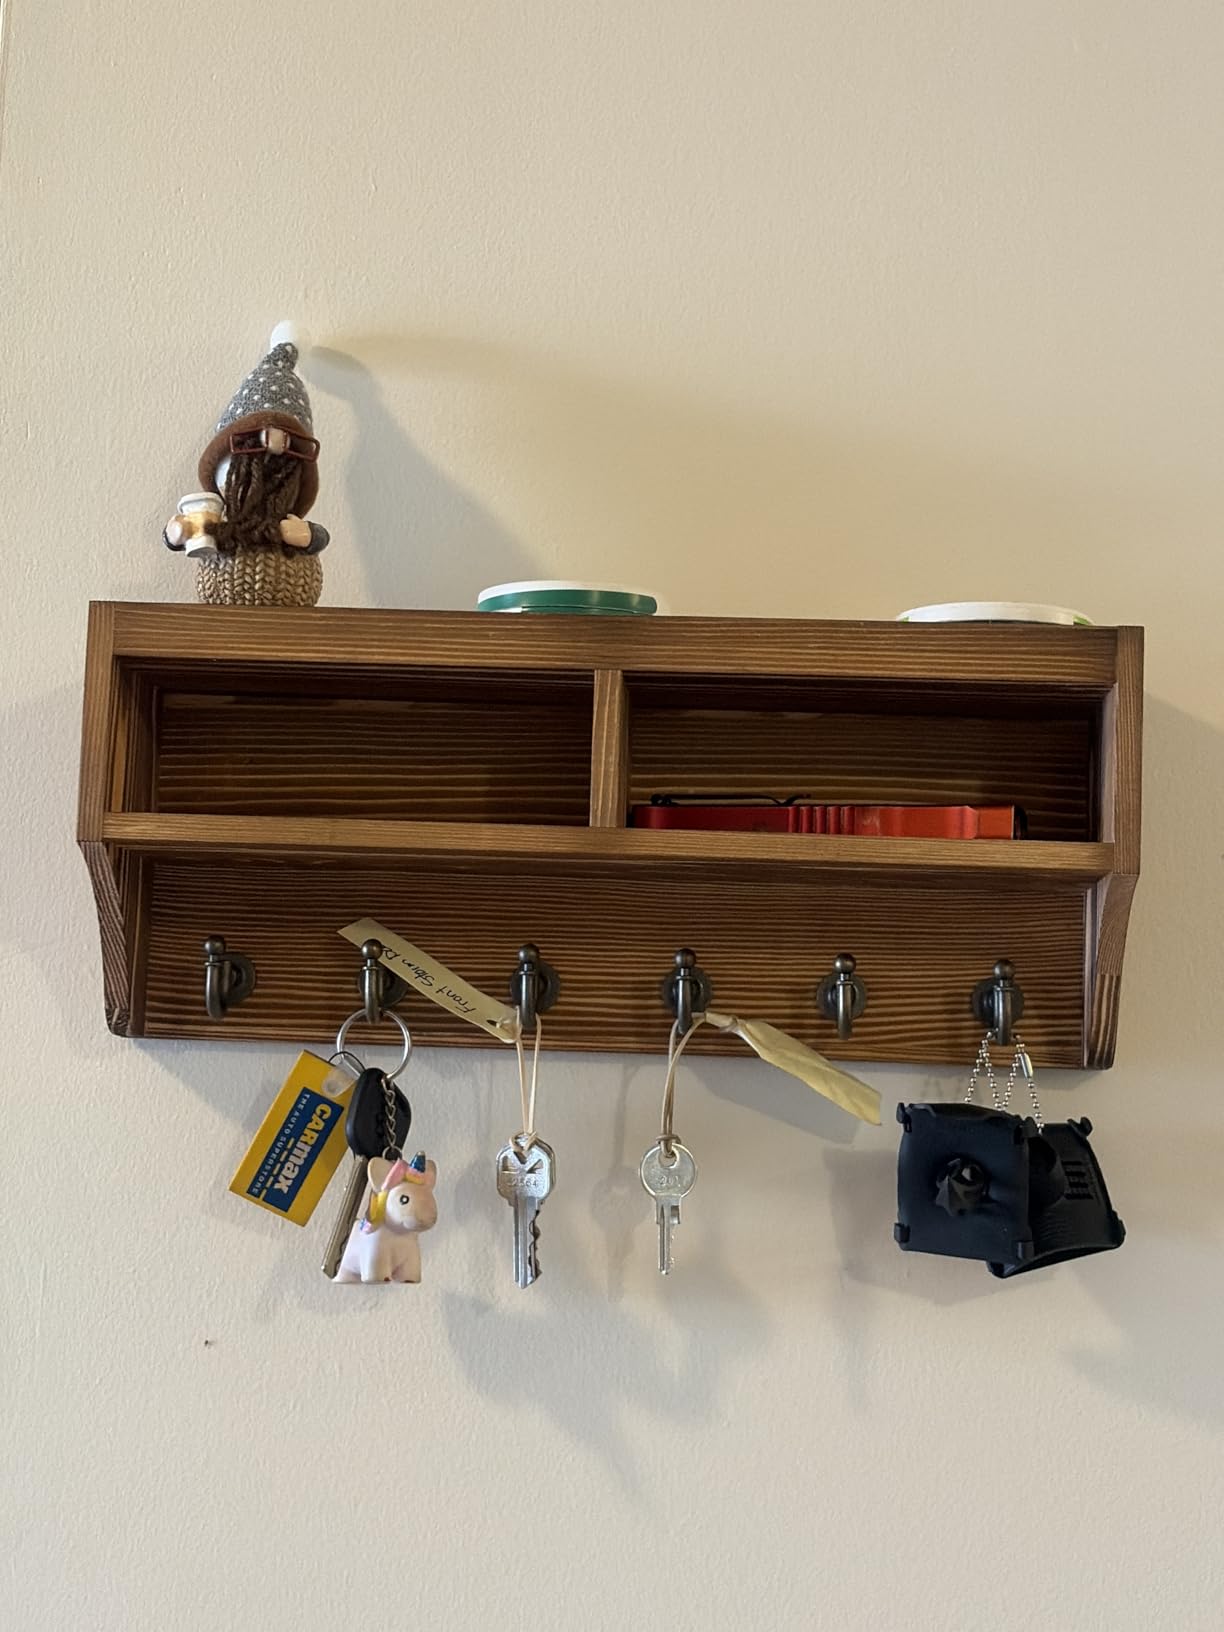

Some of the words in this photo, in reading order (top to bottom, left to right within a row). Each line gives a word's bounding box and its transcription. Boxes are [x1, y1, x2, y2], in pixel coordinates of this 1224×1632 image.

[402, 959, 435, 987] Storm
[436, 985, 476, 1013] Front
[284, 1111, 300, 1135] AUTO
[252, 1136, 287, 1193] SUPERSTORE
